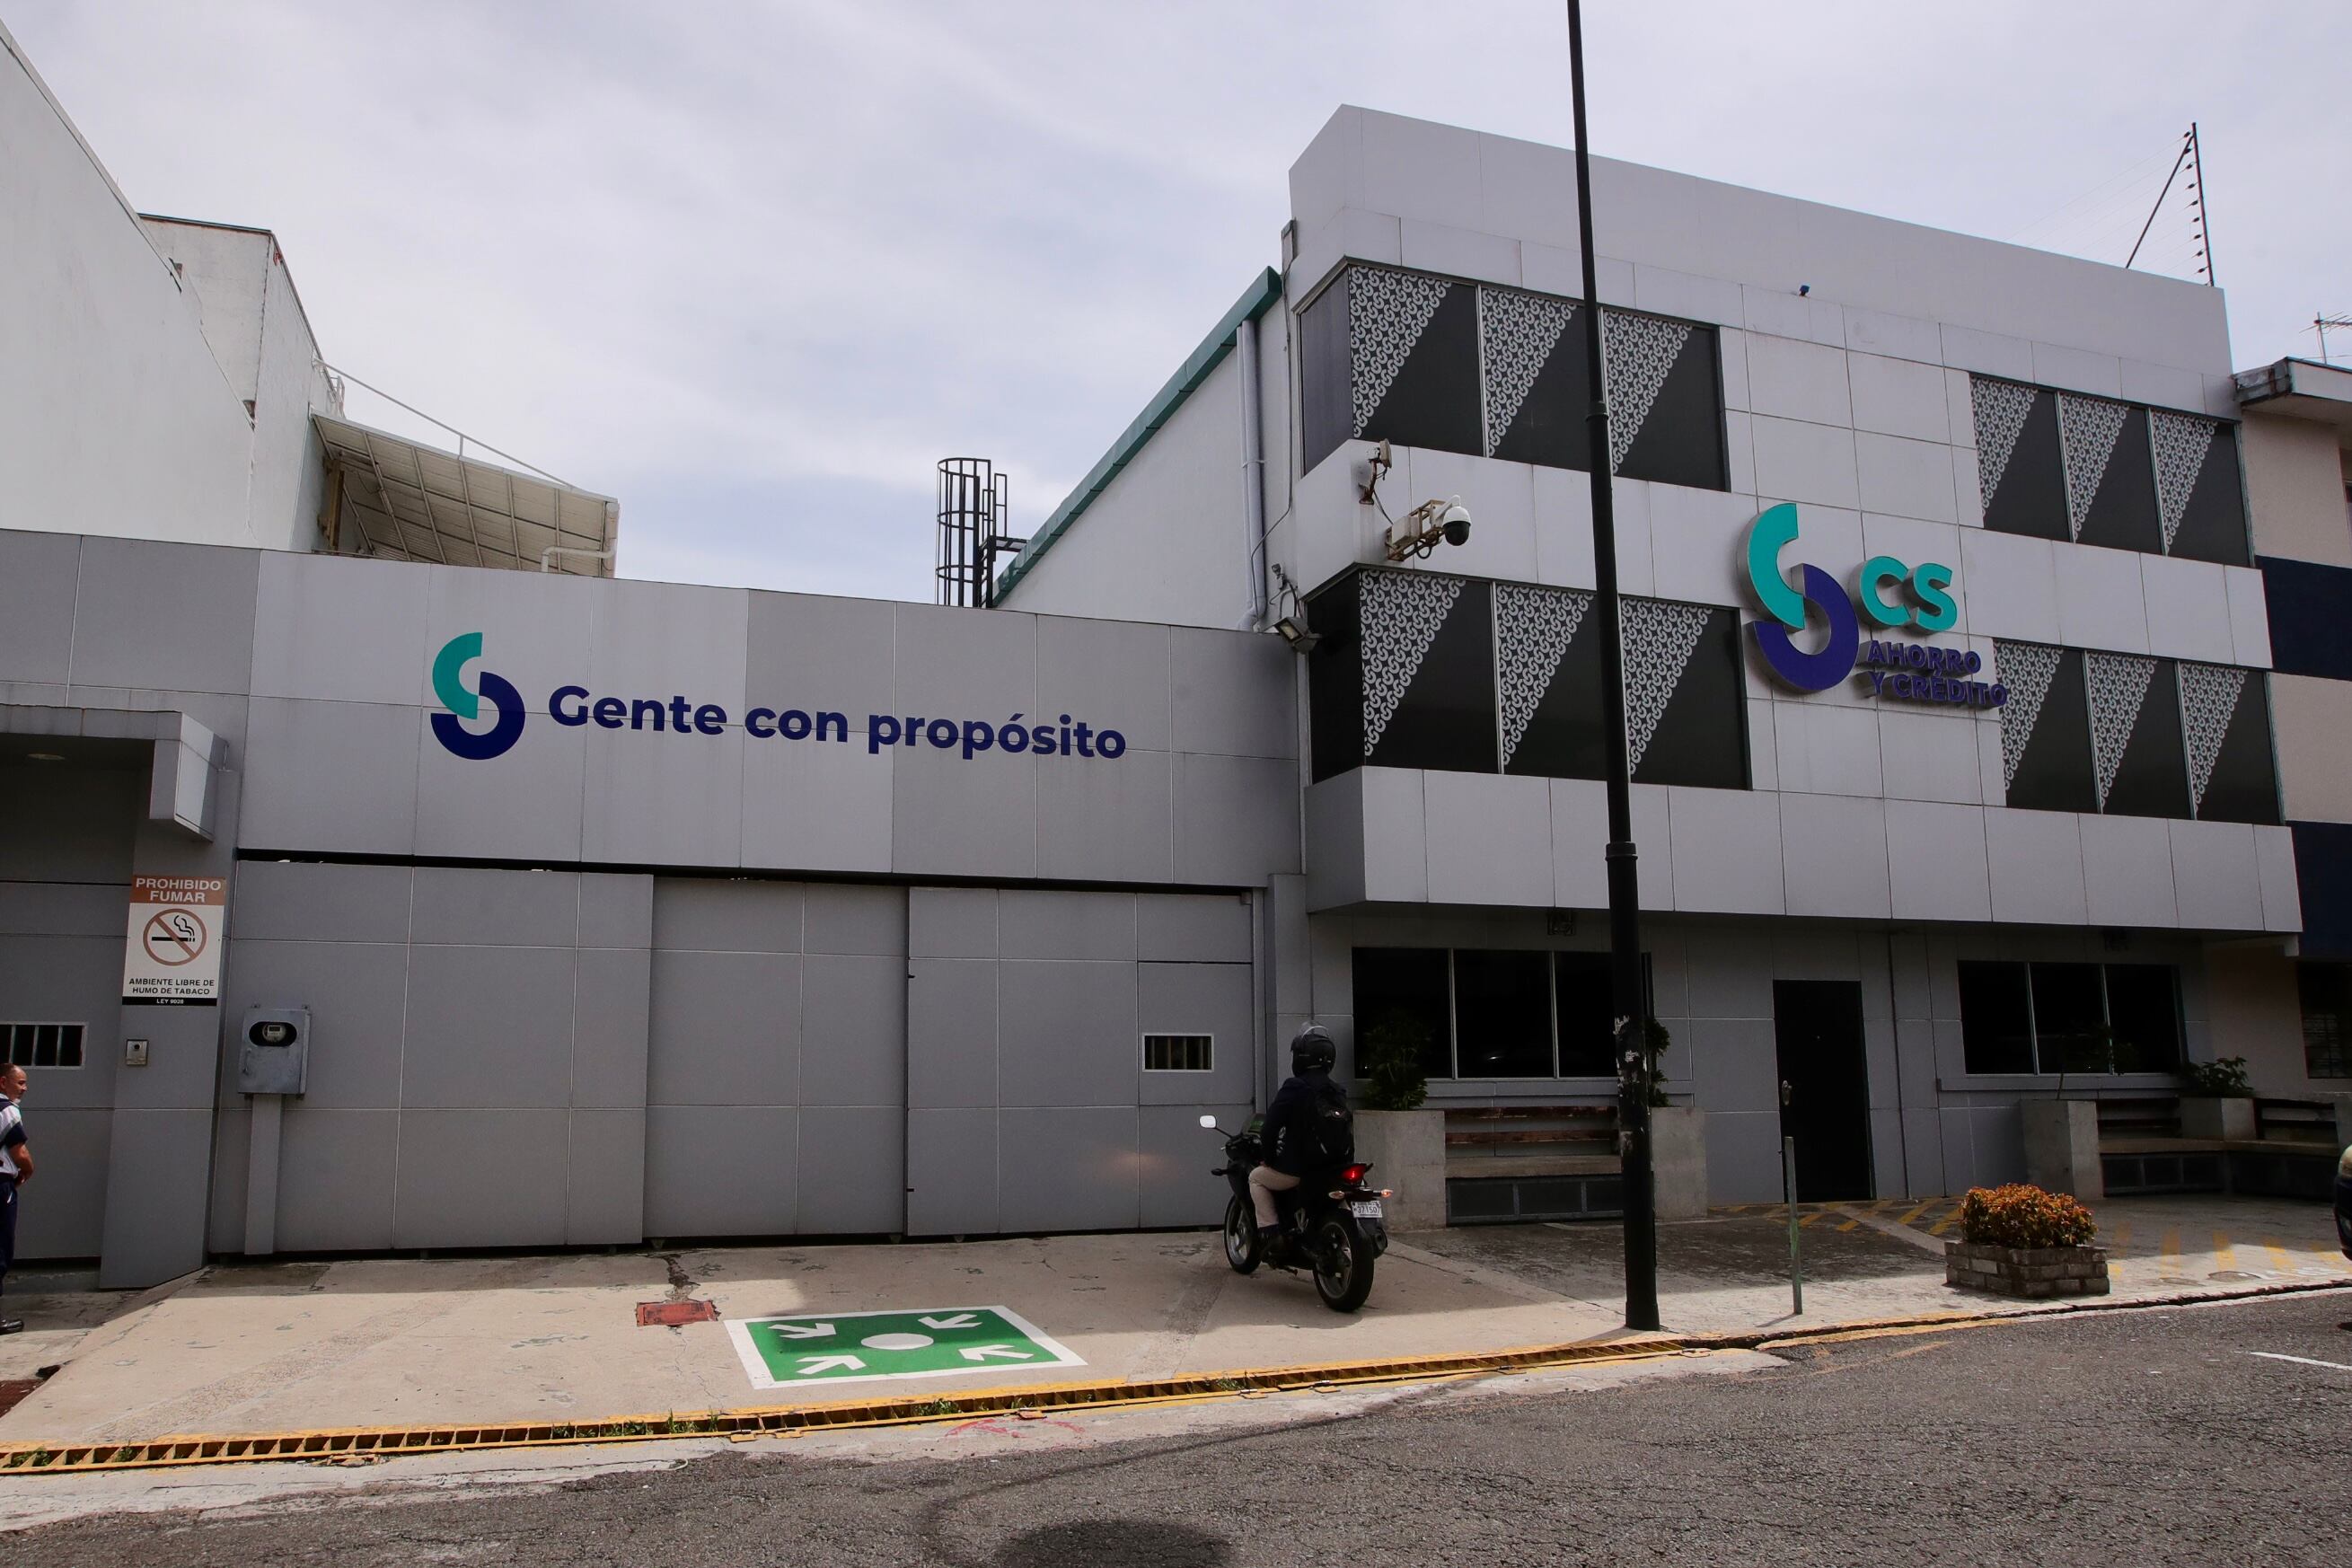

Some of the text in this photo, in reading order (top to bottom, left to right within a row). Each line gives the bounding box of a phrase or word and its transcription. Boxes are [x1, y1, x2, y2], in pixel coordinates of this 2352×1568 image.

[1859, 555, 1958, 632] CS
[1867, 639, 1982, 674] AHORRO
[1868, 668, 2008, 707] Y CRÉDITO
[548, 685, 1127, 761] Gente con propósito
[136, 877, 222, 892] PROHIBIDO
[150, 890, 207, 903] FUMAR
[128, 978, 215, 987] AMBIENTE LIBRE DE
